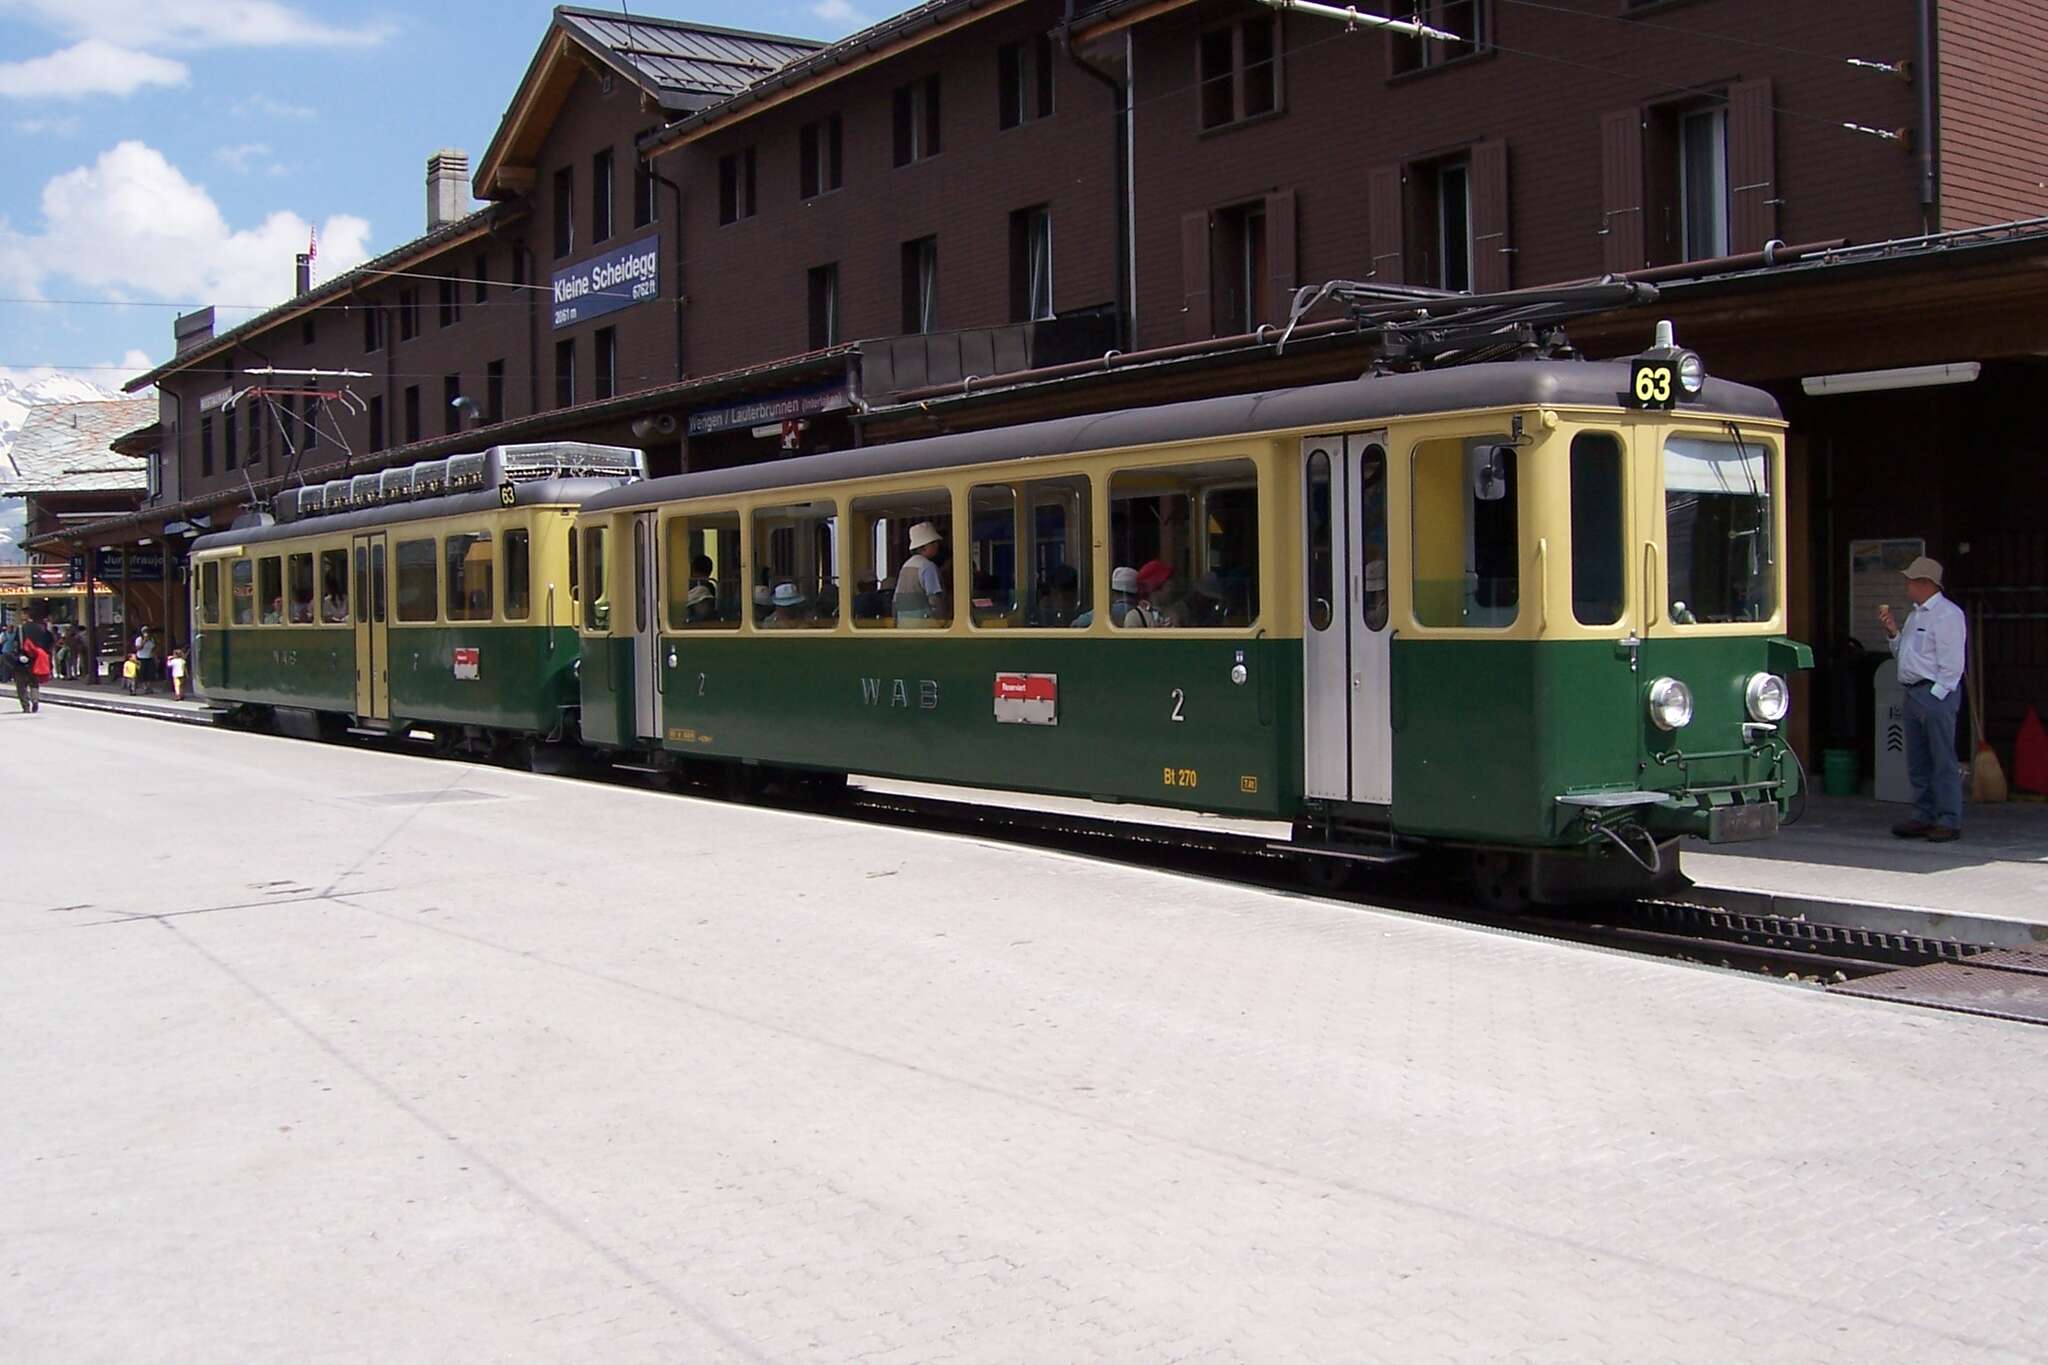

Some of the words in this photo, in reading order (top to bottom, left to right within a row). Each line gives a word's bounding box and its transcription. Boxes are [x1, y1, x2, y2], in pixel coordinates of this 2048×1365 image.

[554, 275, 589, 303] Kleine
[592, 251, 656, 290] Scheidegg
[632, 284, 649, 299] 6762
[649, 280, 656, 293] ft
[555, 309, 569, 324] 2061
[570, 308, 577, 318] m
[1635, 366, 1671, 402] 63
[689, 413, 723, 432] Wengen
[725, 410, 729, 425] /
[731, 399, 799, 423] Lauterbrunnen
[501, 486, 515, 504] 63
[105, 553, 178, 567] Junfraujoh
[697, 672, 706, 696] 2
[1171, 688, 1185, 721] 2
[1164, 768, 1176, 785] Bt
[1179, 769, 1197, 787] 270
